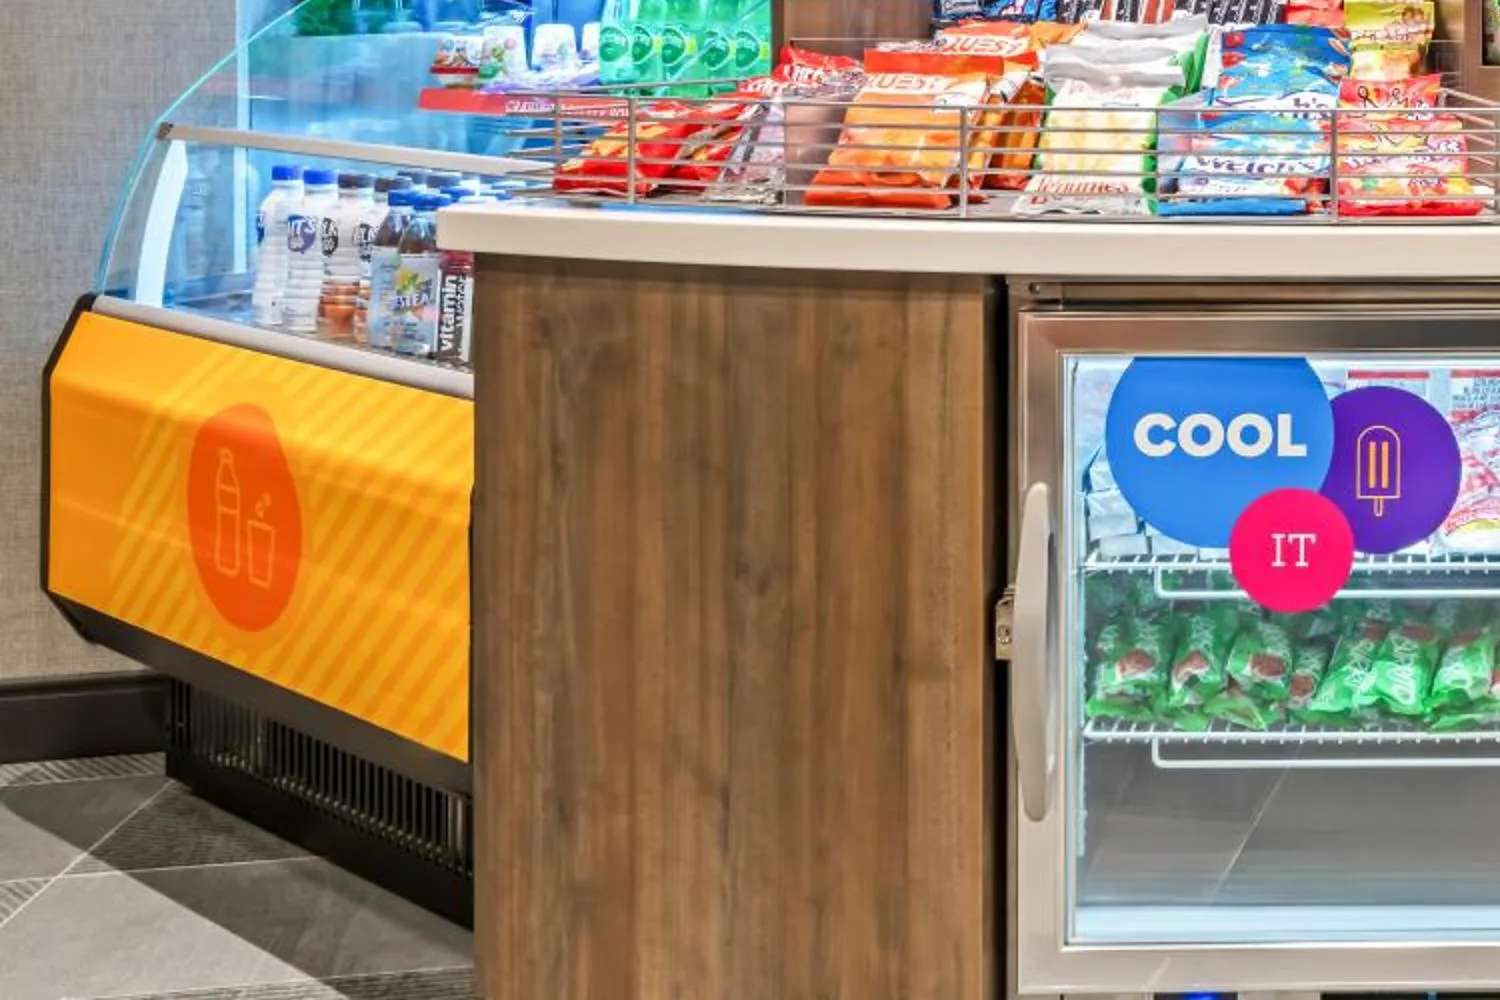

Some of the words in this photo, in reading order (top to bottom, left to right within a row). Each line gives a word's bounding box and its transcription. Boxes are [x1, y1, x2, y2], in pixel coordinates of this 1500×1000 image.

[440, 275, 458, 352] vitamin
[1133, 413, 1308, 458] COOL
[1271, 533, 1317, 568] IT
